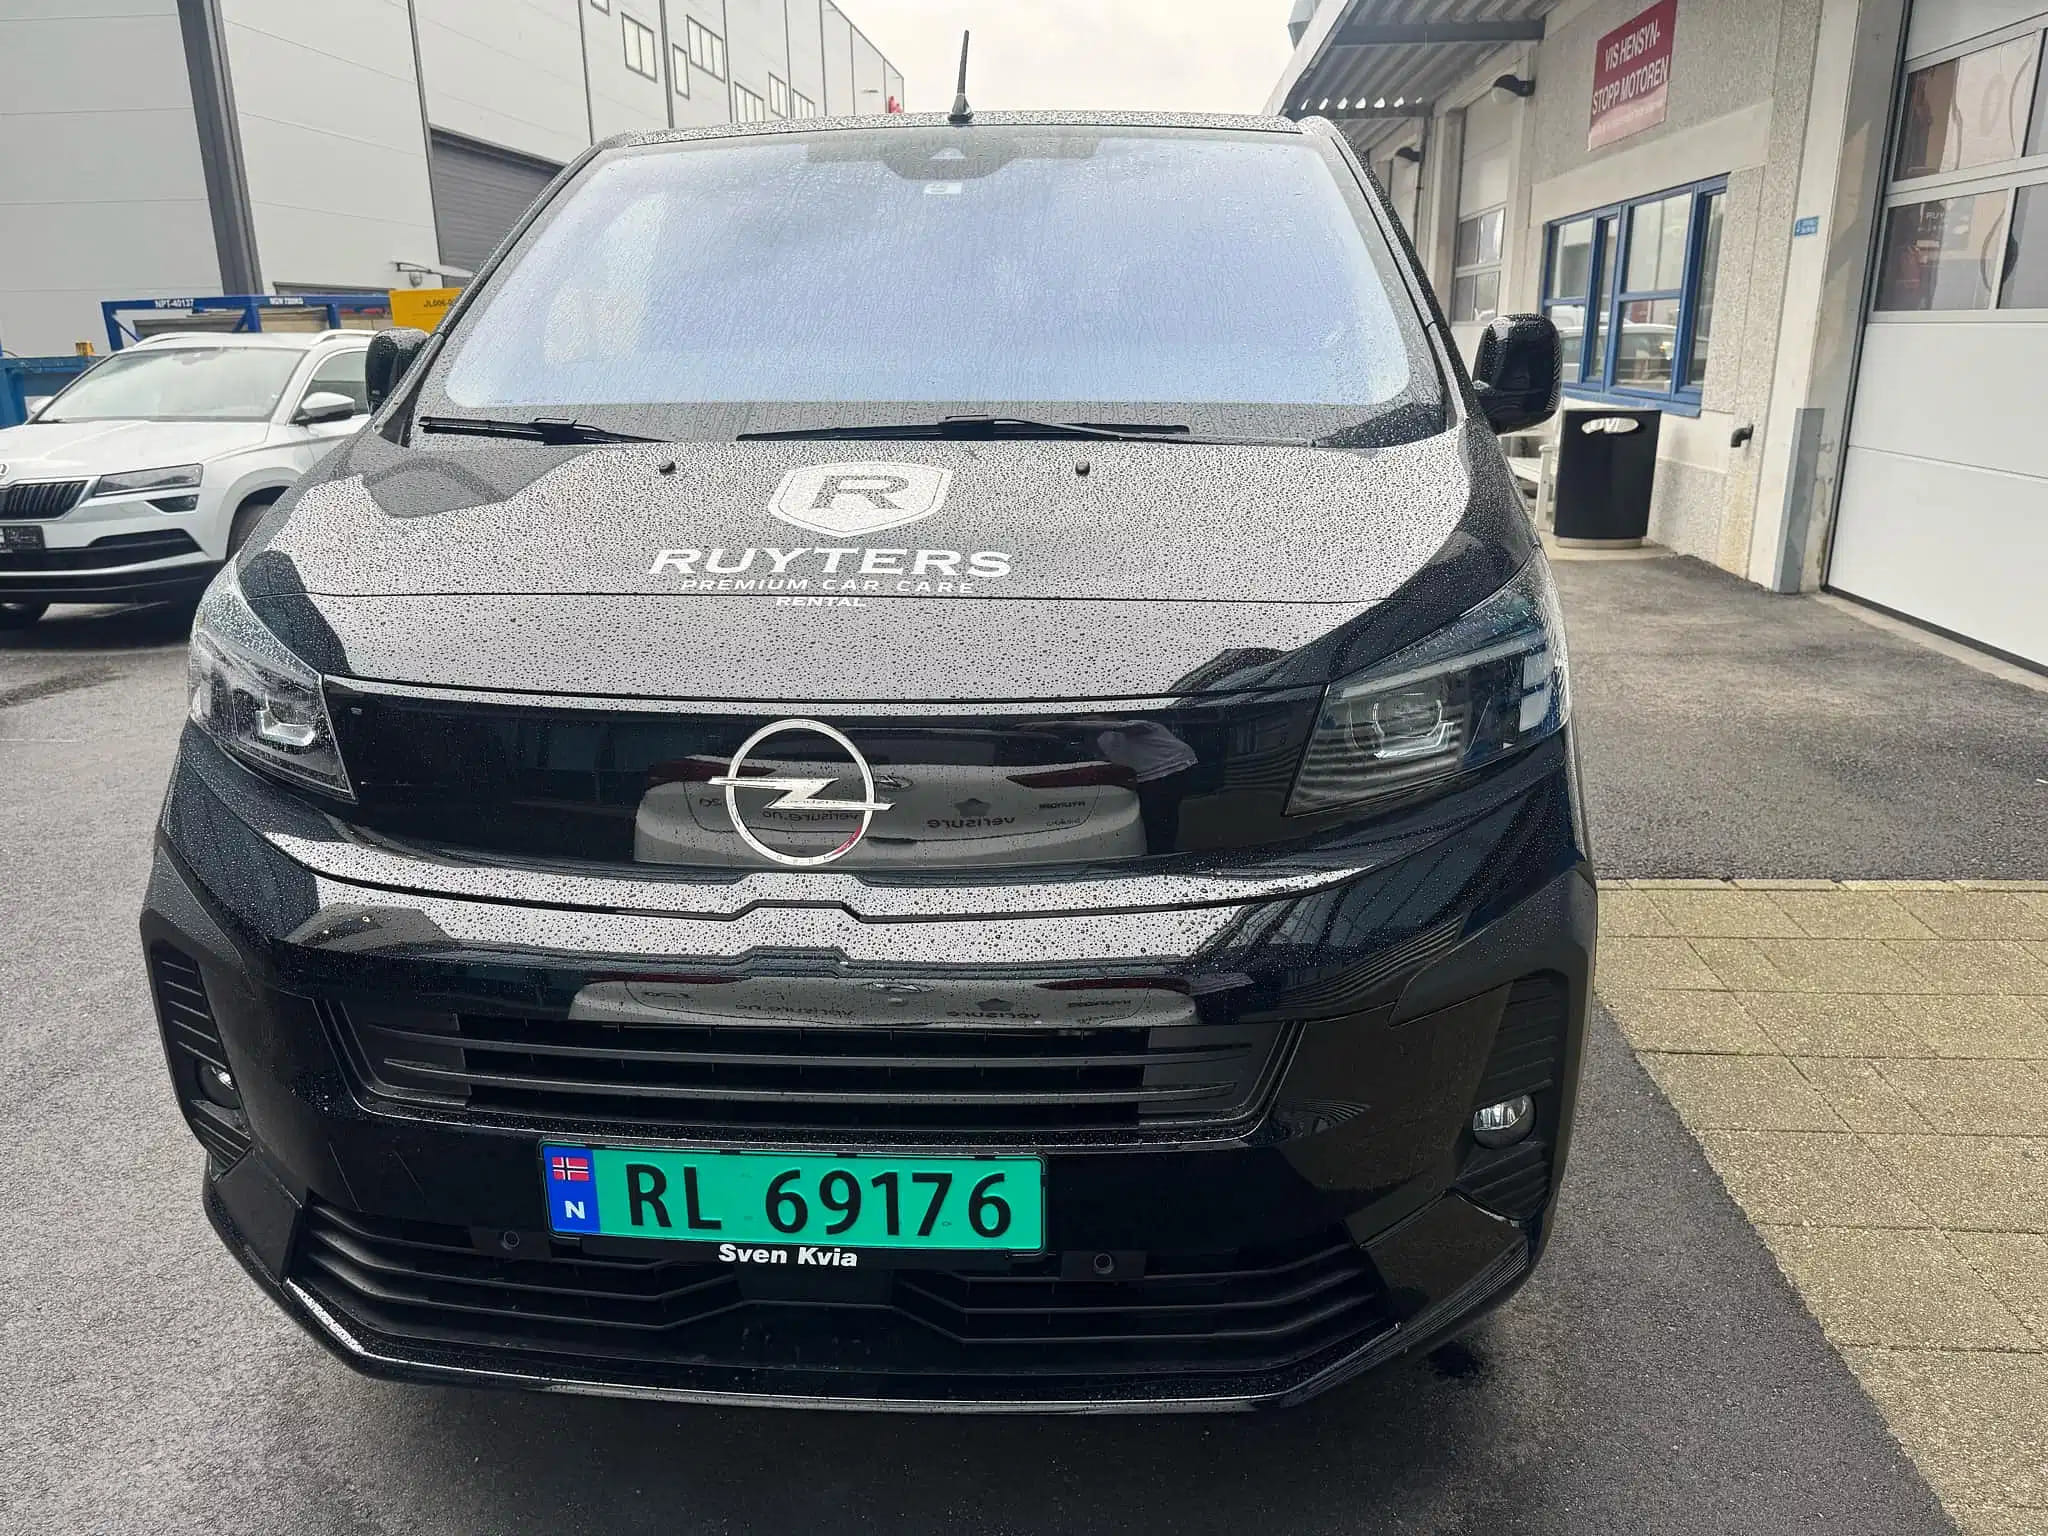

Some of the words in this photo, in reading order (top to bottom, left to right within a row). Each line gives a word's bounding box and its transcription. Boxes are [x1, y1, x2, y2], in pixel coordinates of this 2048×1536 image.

[1605, 42, 1620, 72] VIS
[1620, 19, 1661, 65] HENSYN-
[1592, 80, 1620, 116] STOPP
[1620, 55, 1670, 101] MOTOREN
[811, 474, 909, 509] R
[650, 547, 1012, 577] RUYTERS
[680, 579, 809, 591] PREMIUM
[822, 579, 879, 591] CAR
[897, 581, 974, 594] CARE
[776, 596, 867, 607] RENTAL
[564, 1201, 586, 1221] N
[625, 1163, 723, 1230] RL
[765, 1168, 1012, 1238] 69176
[718, 1243, 788, 1264] Sven
[797, 1246, 858, 1267] Kvia
